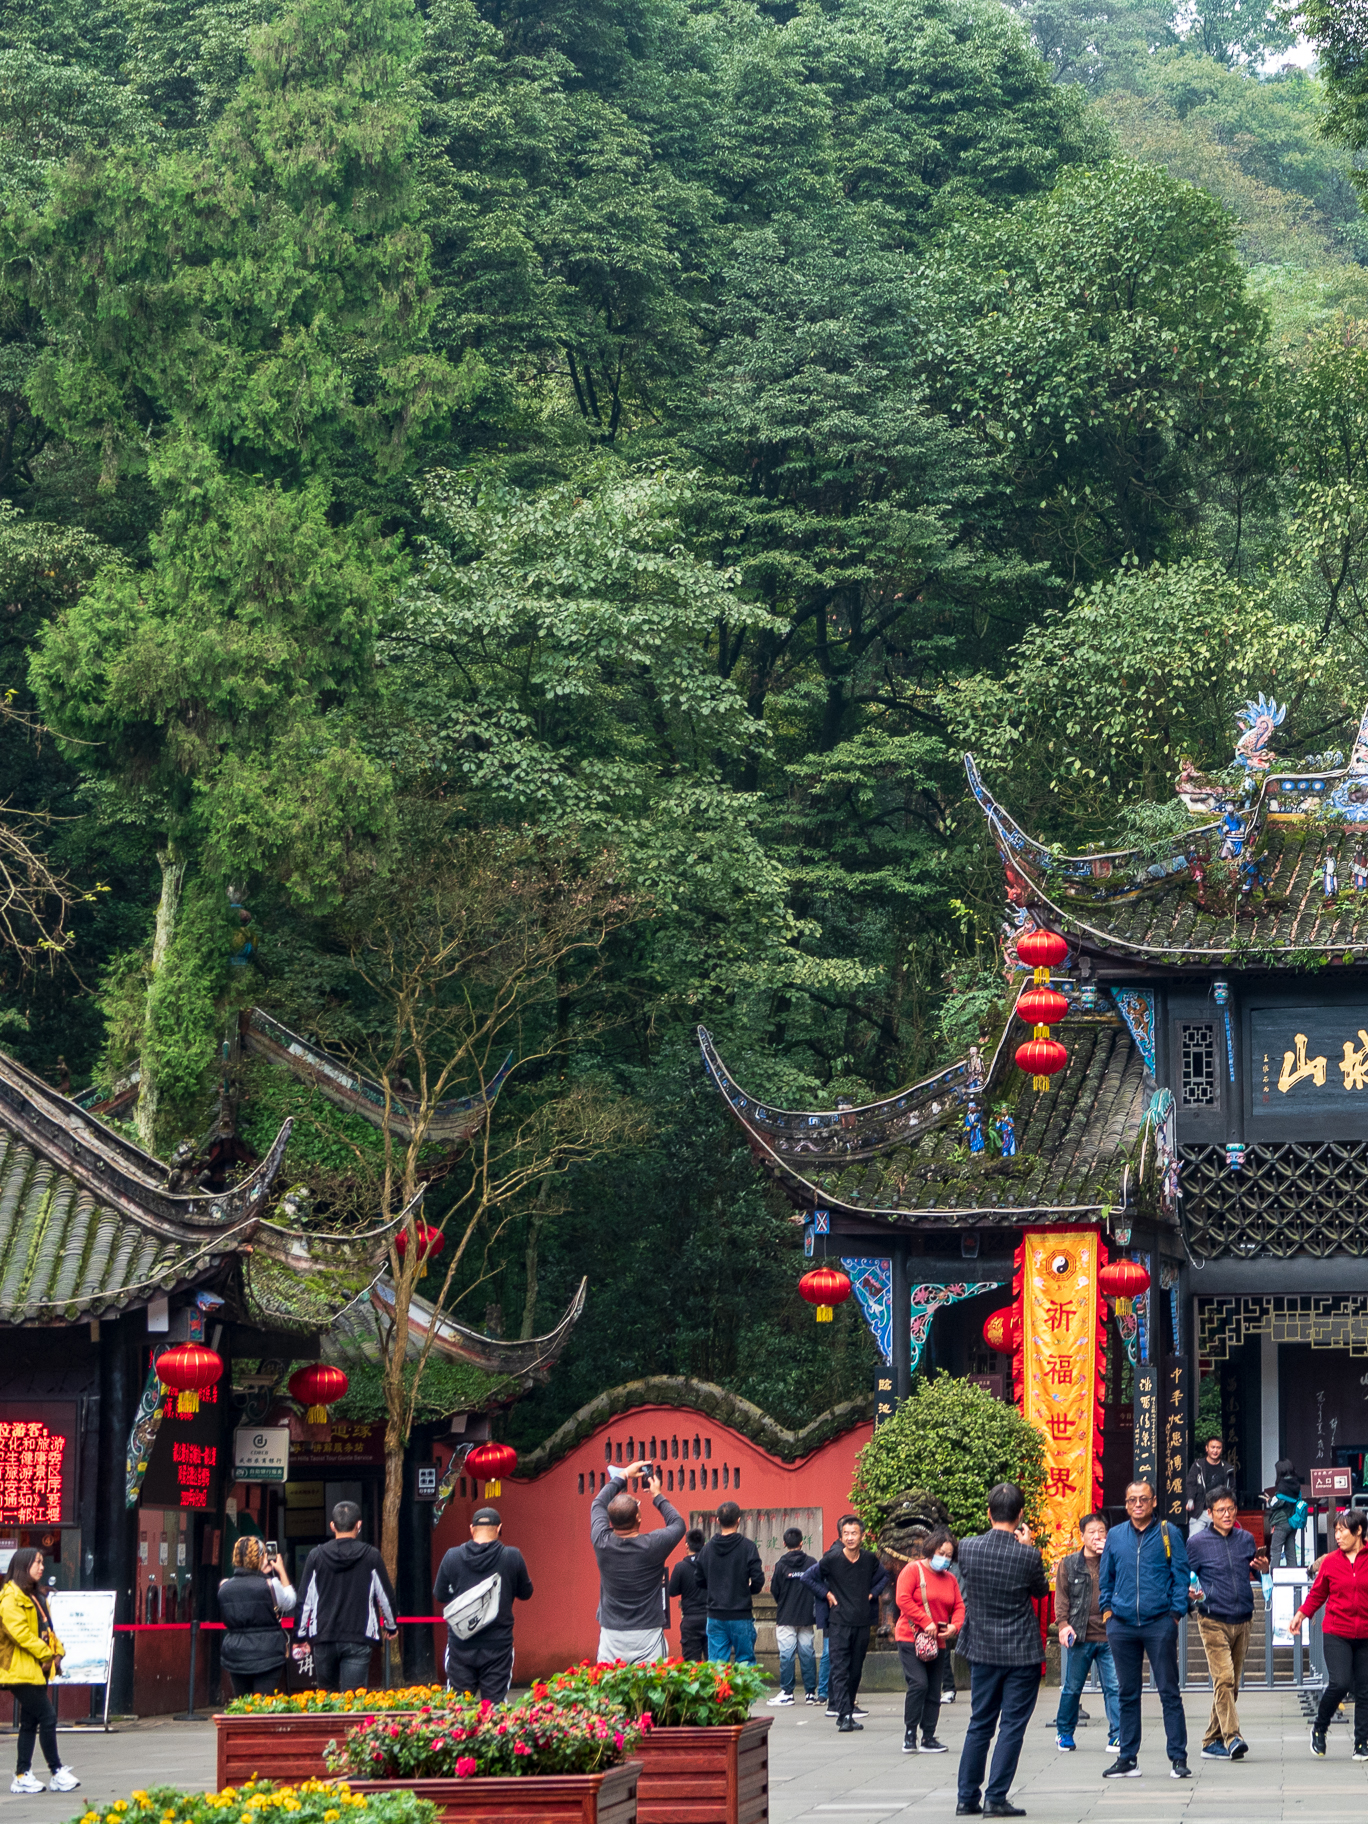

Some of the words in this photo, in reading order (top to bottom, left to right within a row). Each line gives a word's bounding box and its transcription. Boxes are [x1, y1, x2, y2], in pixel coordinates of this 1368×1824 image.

[1044, 1299, 1077, 1499] 祈福世界
[0, 1479, 62, 1493] 安全有序
